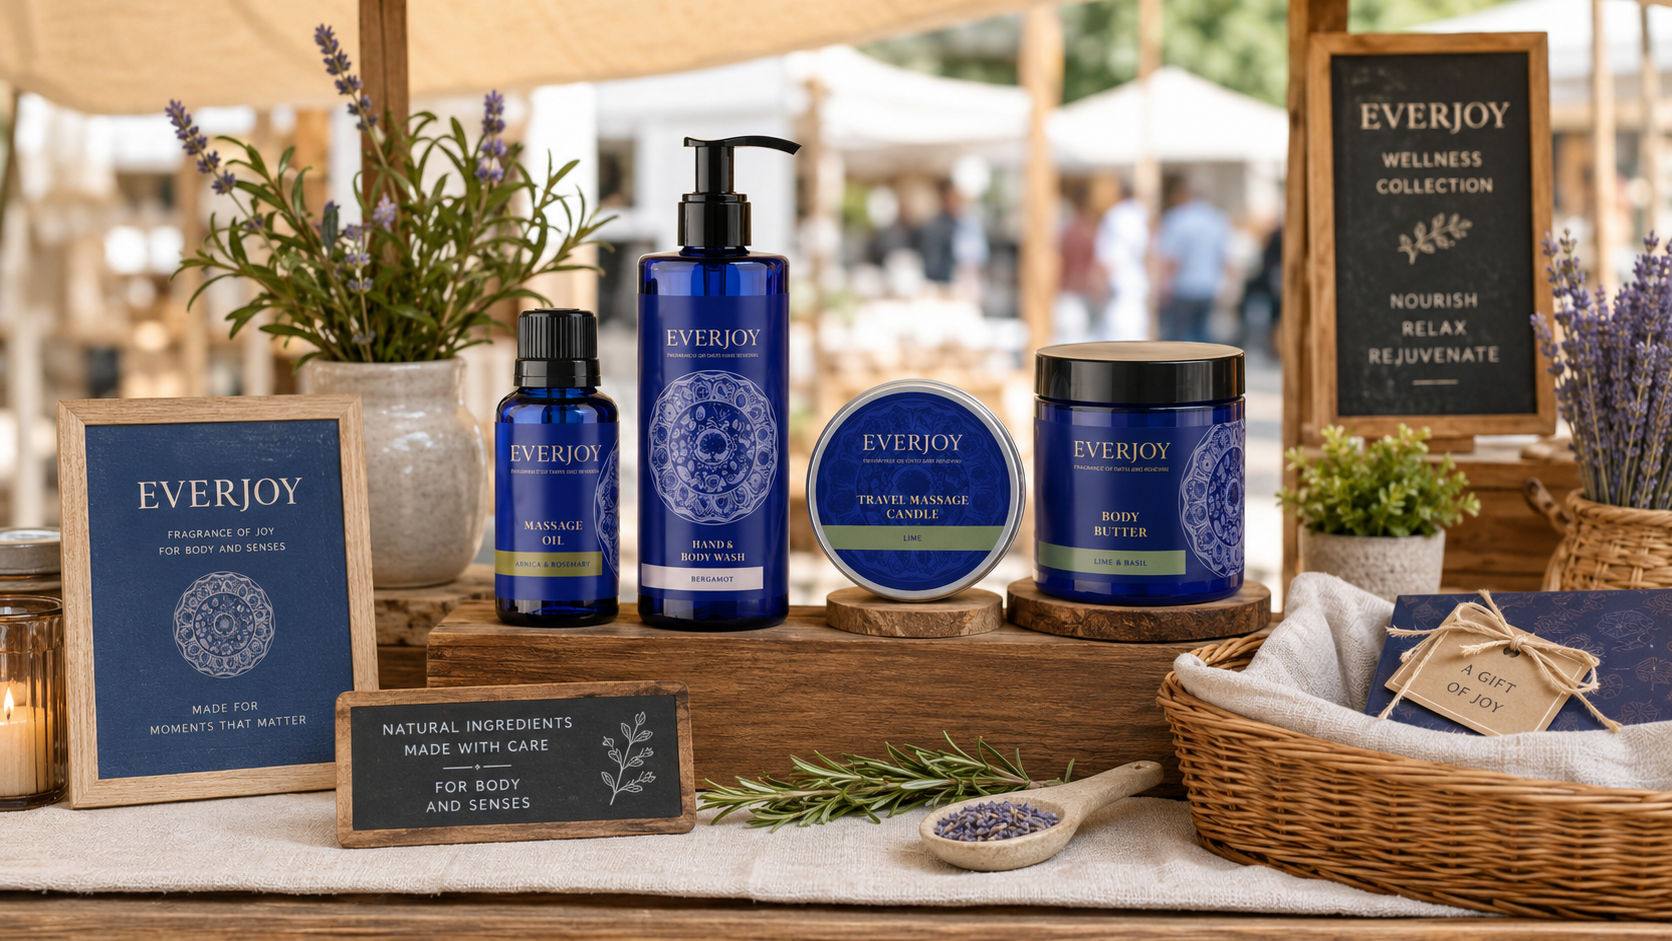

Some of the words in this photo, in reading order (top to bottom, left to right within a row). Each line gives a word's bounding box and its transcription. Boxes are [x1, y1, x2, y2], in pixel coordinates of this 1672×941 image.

[1360, 101, 1511, 134] EVERJOY
[1382, 151, 1483, 168] WELLNESS
[1376, 177, 1493, 194] COLLECTION
[1390, 292, 1478, 309] NOURISH
[1402, 320, 1467, 337] RELAX
[666, 329, 761, 349] EVERJOY
[1368, 346, 1500, 367] REJUVENATE
[863, 434, 963, 455] EVERJOY
[1074, 440, 1171, 464] EVERJOY
[510, 444, 602, 466] EVERJOY
[137, 477, 303, 512] EVERJOY
[856, 494, 906, 505] TRAVEL
[909, 495, 969, 505] MASSAGE
[886, 509, 939, 519] CANDLE
[1102, 511, 1140, 523] BODY
[167, 528, 233, 539] FRAGRANCE
[237, 527, 251, 537] OF
[255, 527, 275, 537] JOY
[524, 520, 583, 531] MASSAGE
[1094, 526, 1148, 538] BUTTER
[159, 546, 180, 556] FOR
[185, 544, 214, 555] BODY
[219, 543, 242, 553] AND
[246, 542, 286, 552] SENSES
[542, 535, 564, 546] OIL
[692, 540, 724, 550] HAND
[726, 540, 734, 550] &
[681, 552, 712, 562] BODY
[714, 552, 745, 562] WASH
[1094, 558, 1113, 566] LIME
[1124, 559, 1148, 567] BASIL
[690, 575, 734, 583] BERGAMOT
[1461, 664, 1473, 676] A
[1477, 671, 1517, 693] GIFT
[1447, 681, 1471, 696] OF
[1469, 693, 1504, 713] JOY
[192, 704, 228, 715] MADE
[234, 701, 258, 712] FOR
[150, 721, 214, 735] MOMENTS
[220, 718, 251, 730] THAT
[257, 715, 307, 728] MATTER
[382, 721, 460, 736] NATURAL
[466, 716, 573, 732] INGREDIENTS
[404, 743, 451, 757] MADE
[458, 741, 500, 754] WITH
[507, 739, 549, 753] CARE
[435, 780, 468, 794] FOR
[476, 778, 521, 792] BODY
[426, 800, 461, 813] AND
[469, 796, 531, 811] SENSES
